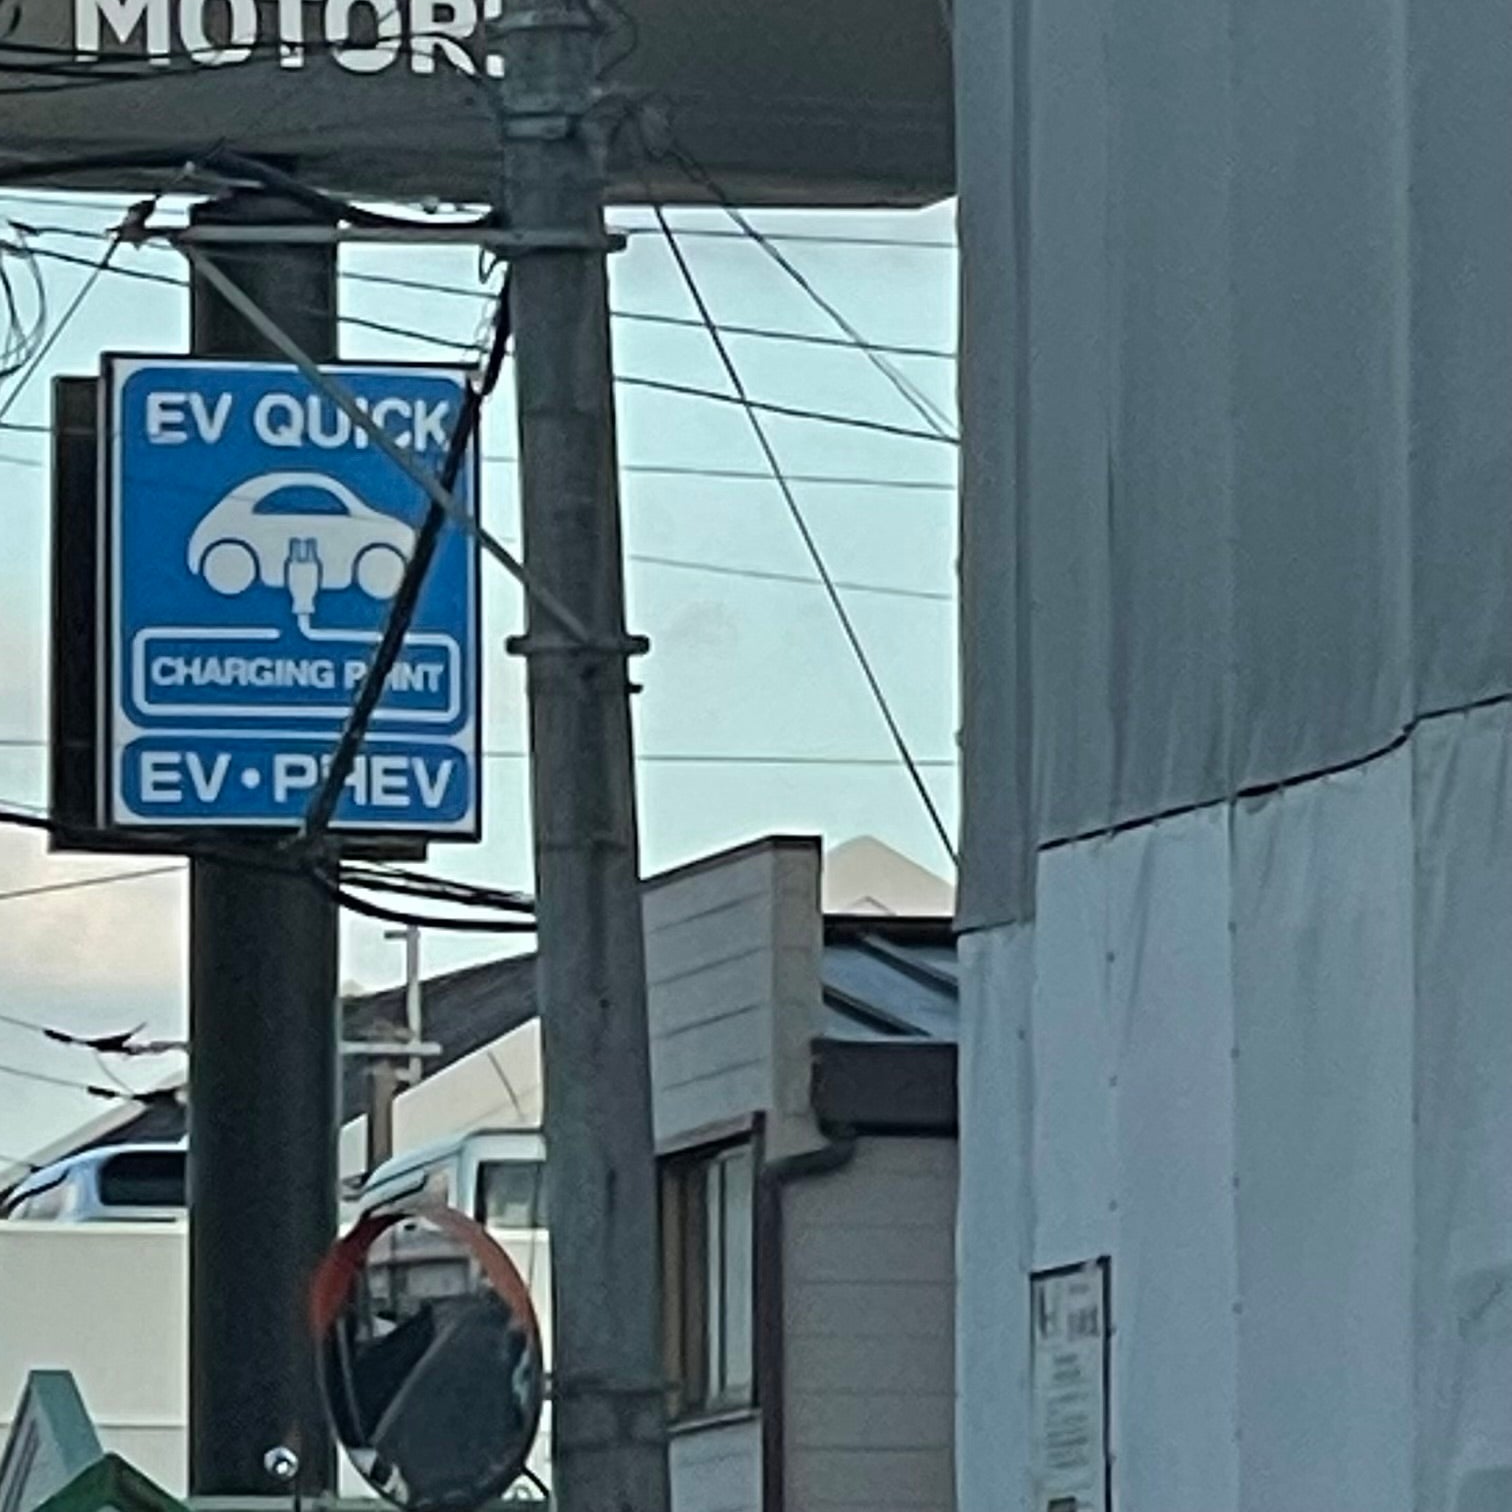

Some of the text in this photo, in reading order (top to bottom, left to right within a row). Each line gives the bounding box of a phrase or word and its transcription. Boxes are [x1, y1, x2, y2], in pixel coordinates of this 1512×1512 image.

[146, 392, 450, 452] EV QUICK
[151, 656, 443, 693] CHARGING PINT
